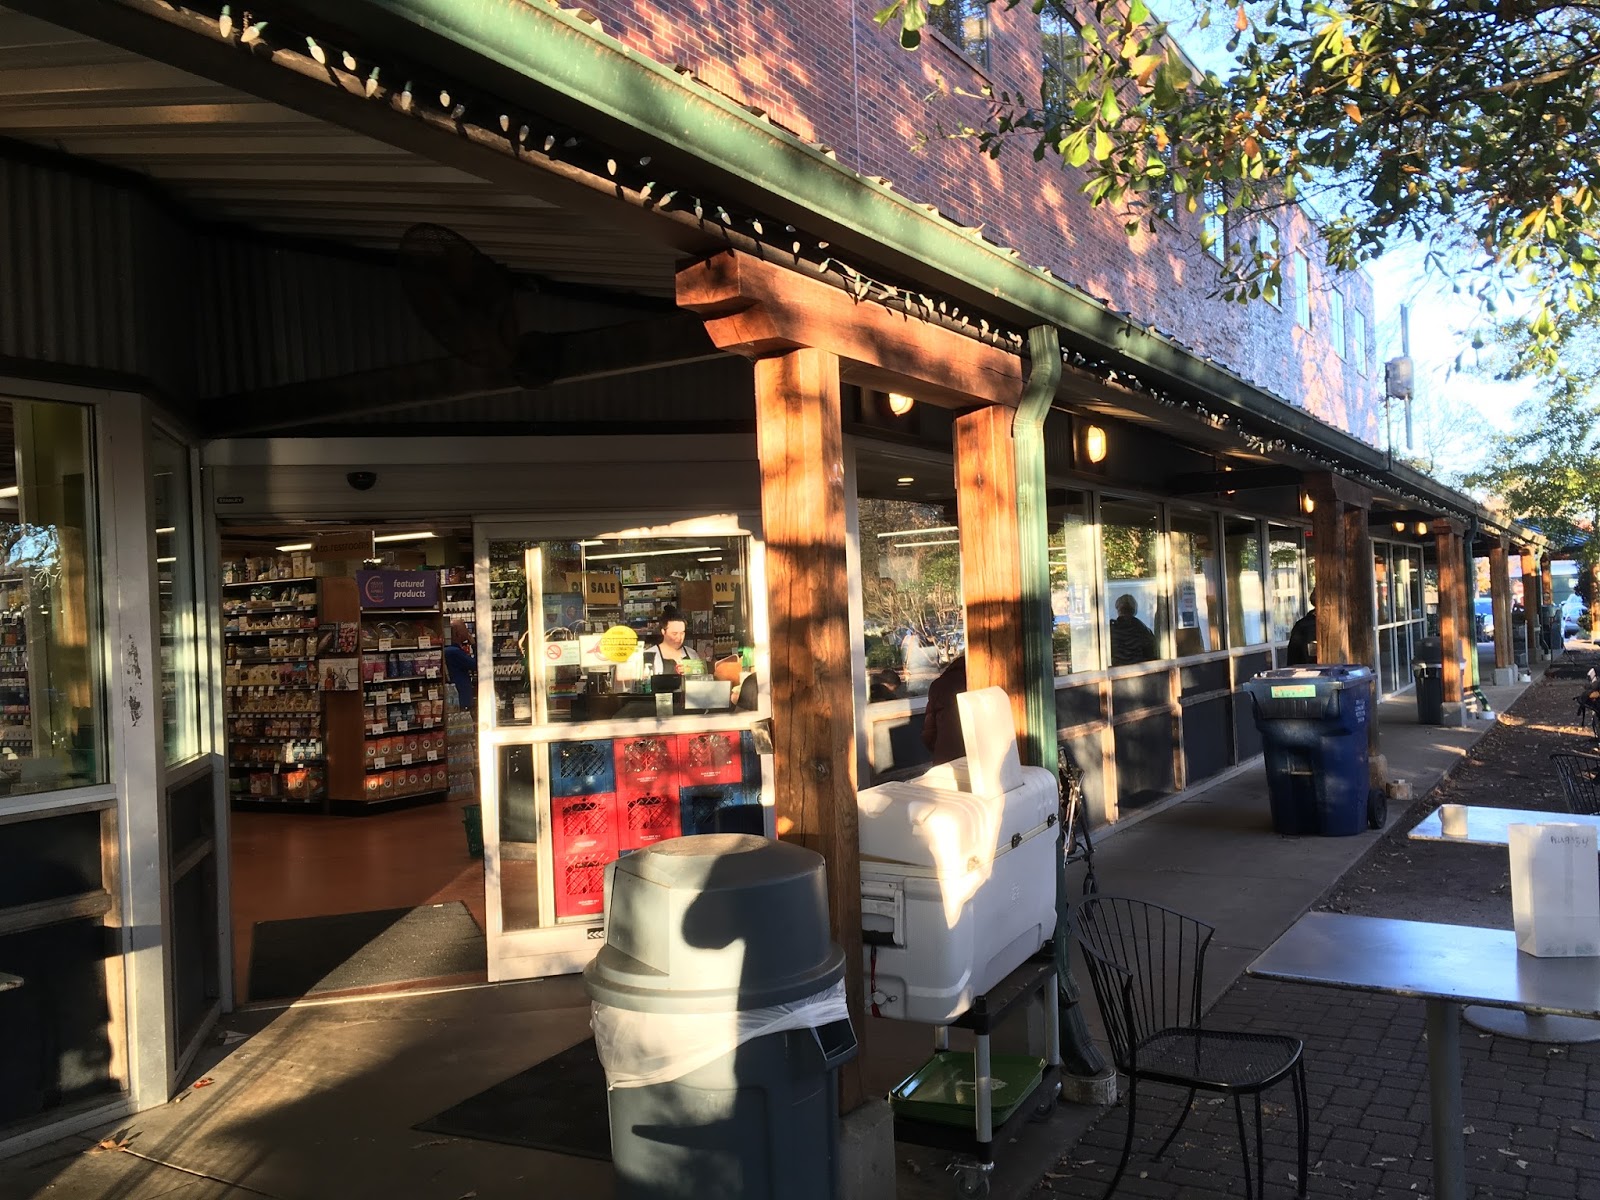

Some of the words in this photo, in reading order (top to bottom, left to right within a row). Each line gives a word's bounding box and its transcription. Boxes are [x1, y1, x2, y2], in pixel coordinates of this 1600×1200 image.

[393, 578, 425, 588] featured
[591, 582, 616, 594] SALE
[715, 582, 728, 593] ON
[393, 589, 426, 600] products
